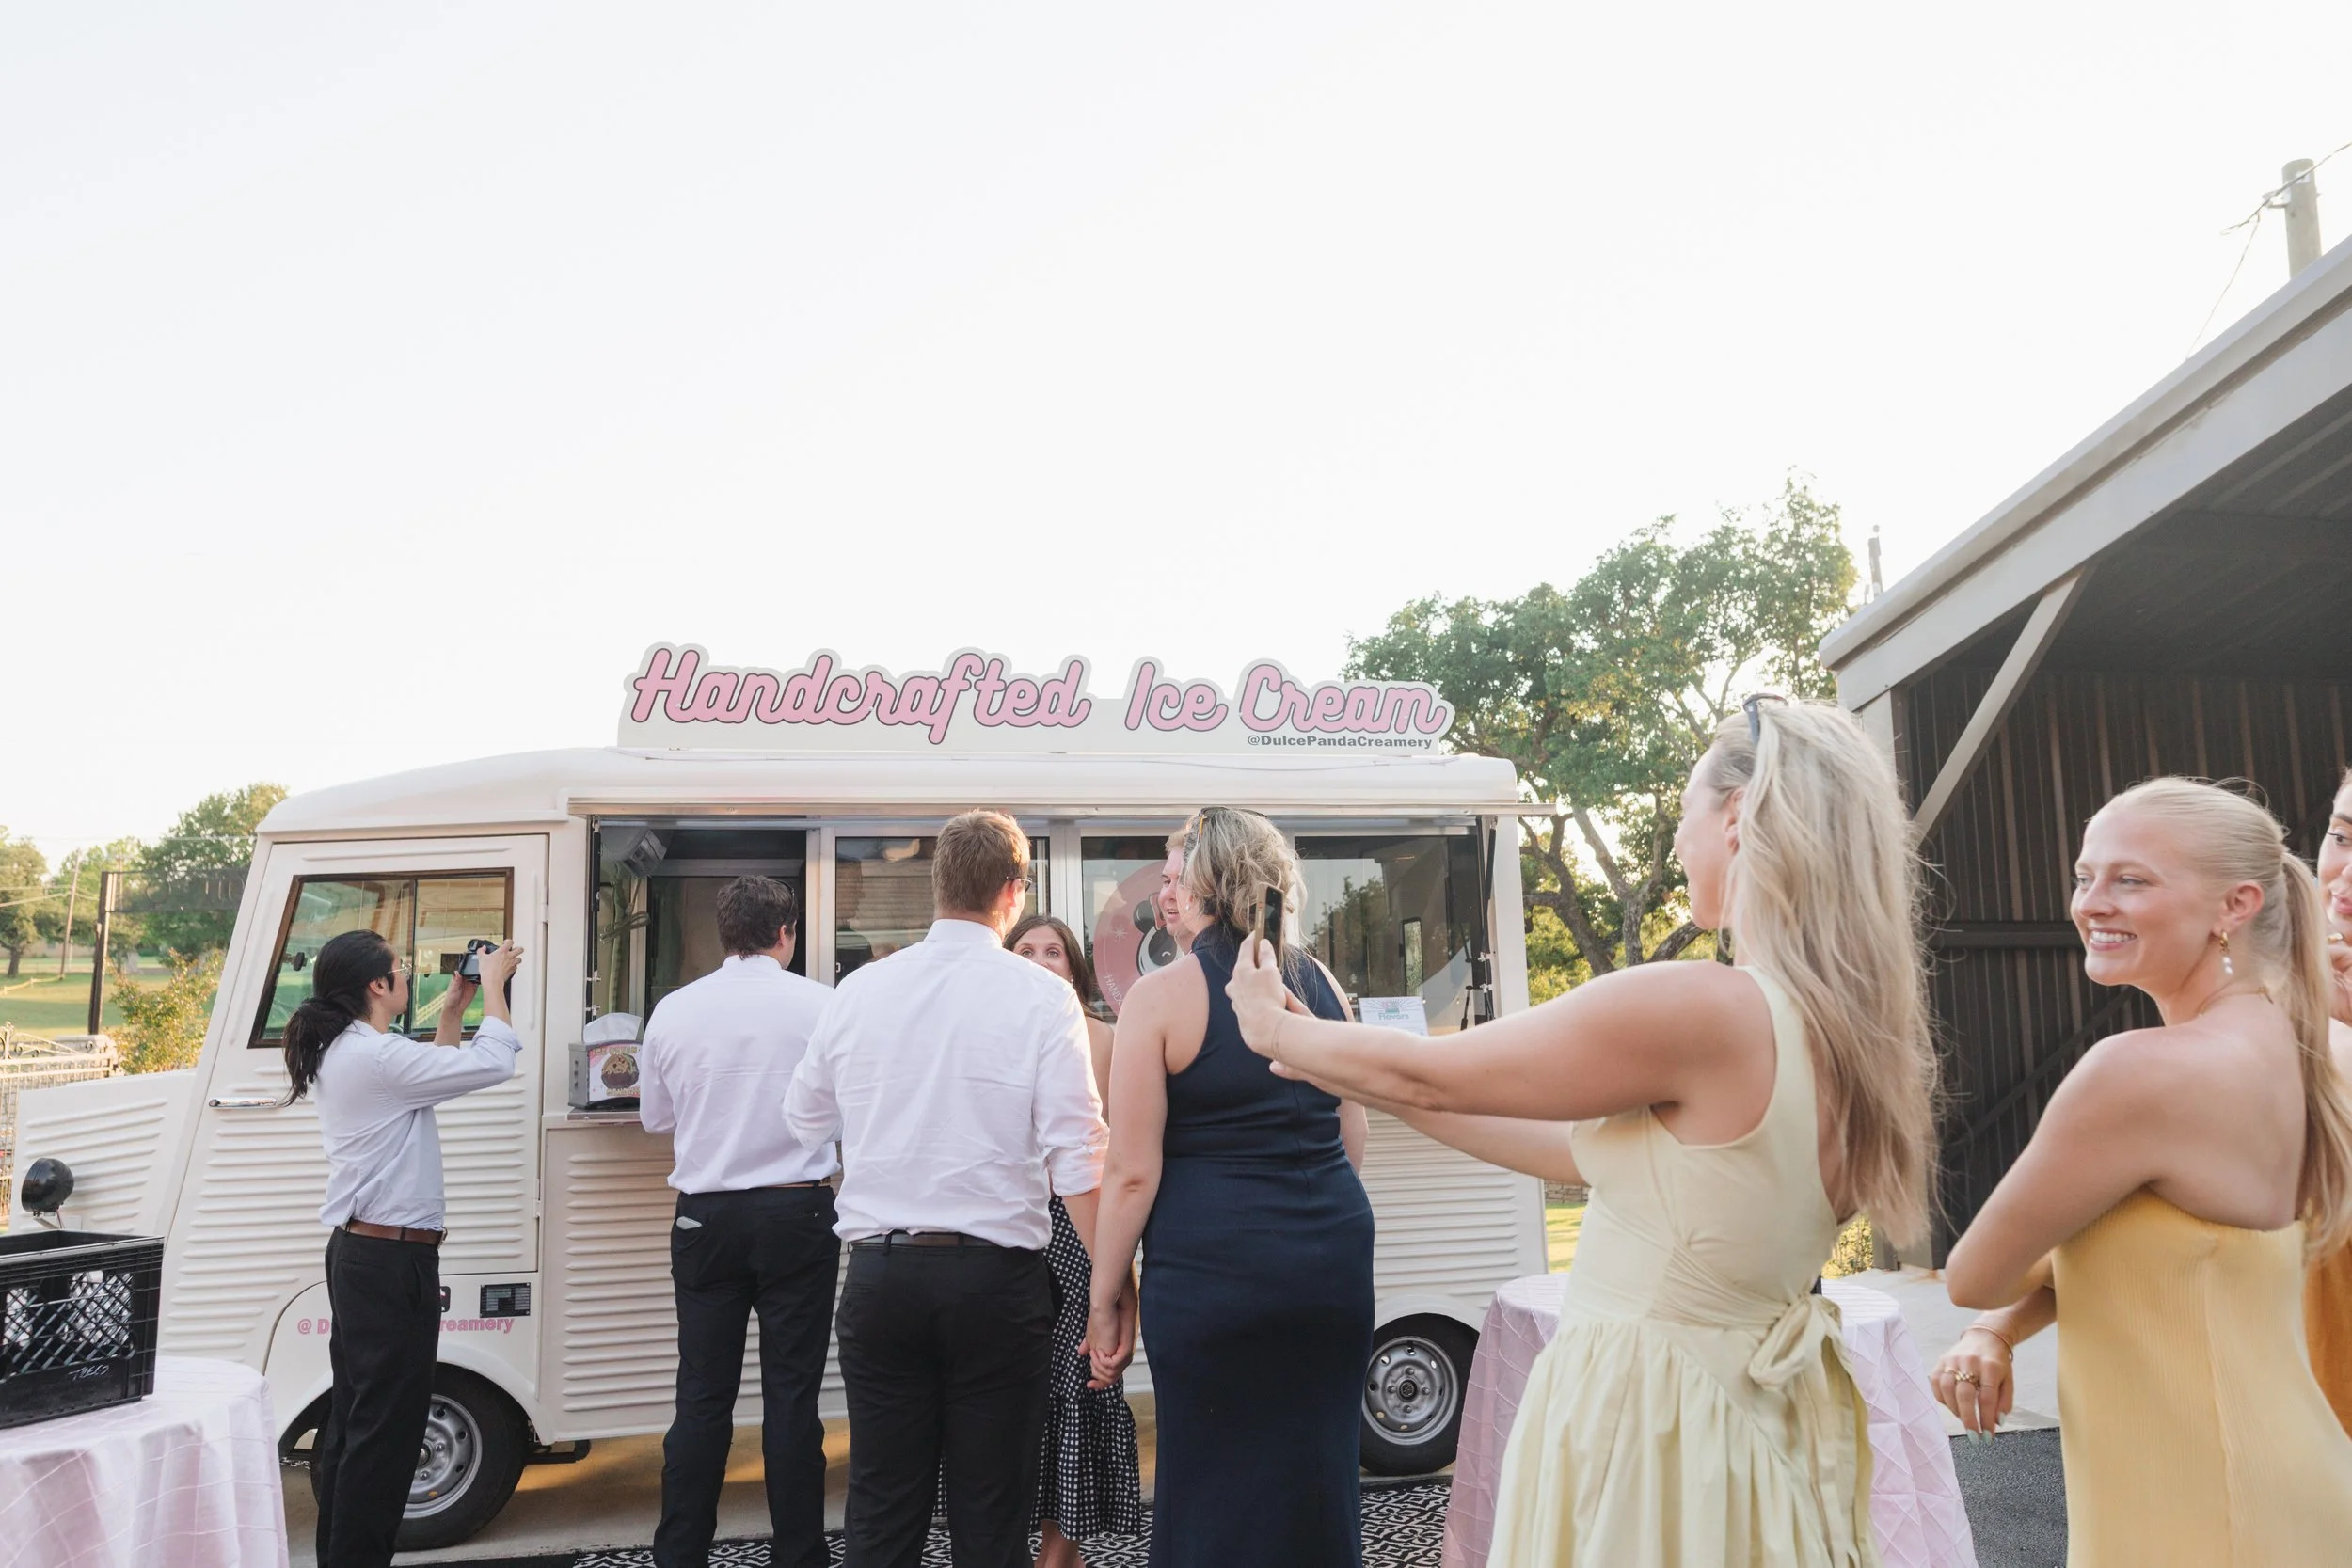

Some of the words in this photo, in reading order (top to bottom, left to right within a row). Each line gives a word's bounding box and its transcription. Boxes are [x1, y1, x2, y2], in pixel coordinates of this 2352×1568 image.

[631, 648, 1092, 745] Handcrafted
[1124, 661, 1229, 733] Ice
[1238, 663, 1448, 735] Cream
[1247, 735, 1433, 749] @DulcePandaCreamery
[439, 1317, 514, 1333] reamery
